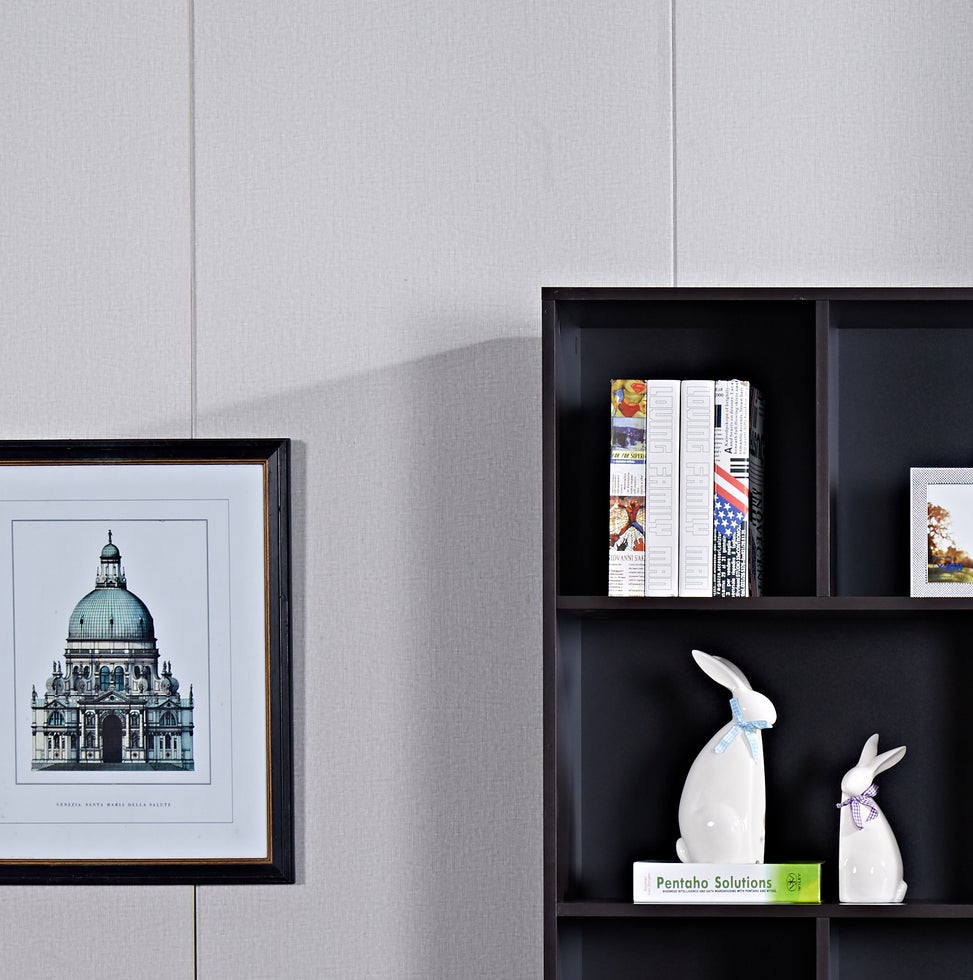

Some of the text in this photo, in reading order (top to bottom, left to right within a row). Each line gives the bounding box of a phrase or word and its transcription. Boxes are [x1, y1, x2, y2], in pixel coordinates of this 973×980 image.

[649, 462, 672, 536] FAMILY
[686, 462, 710, 536] FAMILY
[656, 876, 708, 888] Pentaho
[714, 876, 772, 888] Solutions
